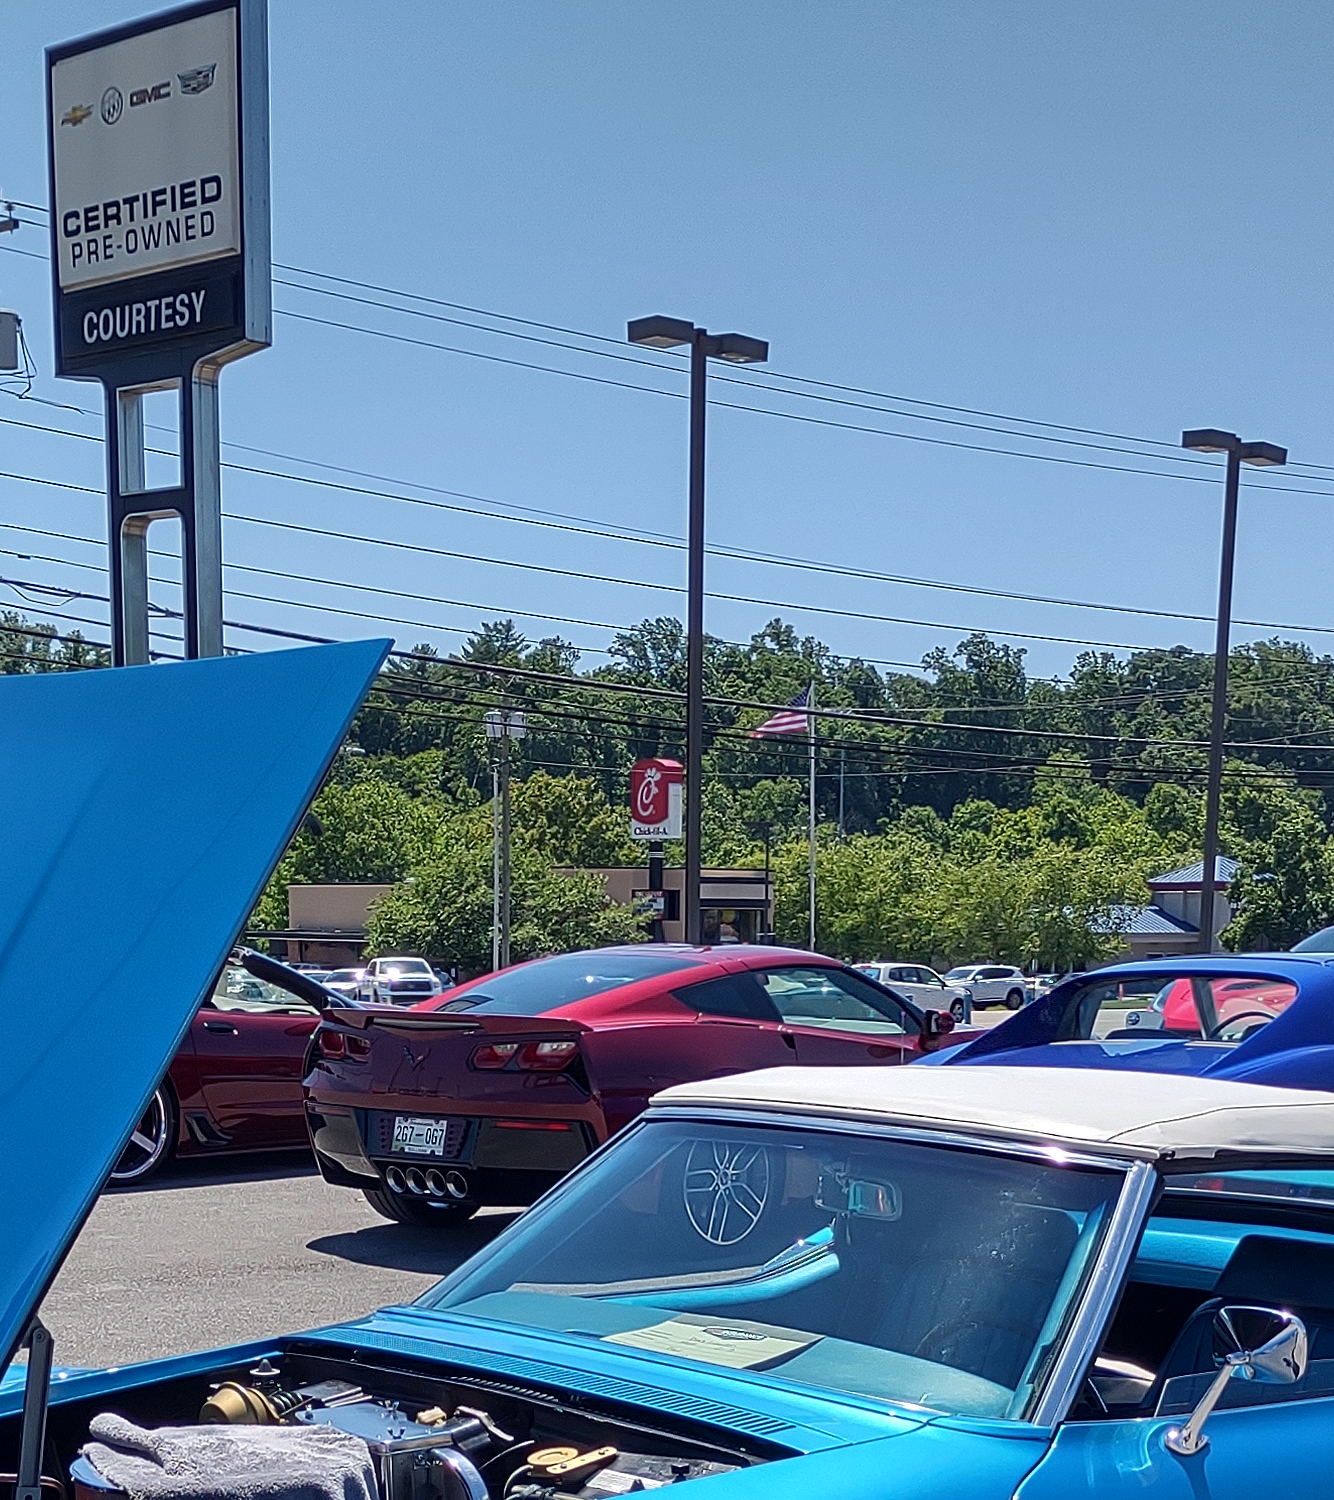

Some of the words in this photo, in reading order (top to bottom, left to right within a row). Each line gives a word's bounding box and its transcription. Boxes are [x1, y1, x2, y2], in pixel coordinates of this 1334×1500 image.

[129, 82, 171, 108] GMC
[63, 175, 222, 238] CERTIFIED
[72, 210, 215, 268] PRE-OWNED
[83, 290, 206, 344] COURTESY
